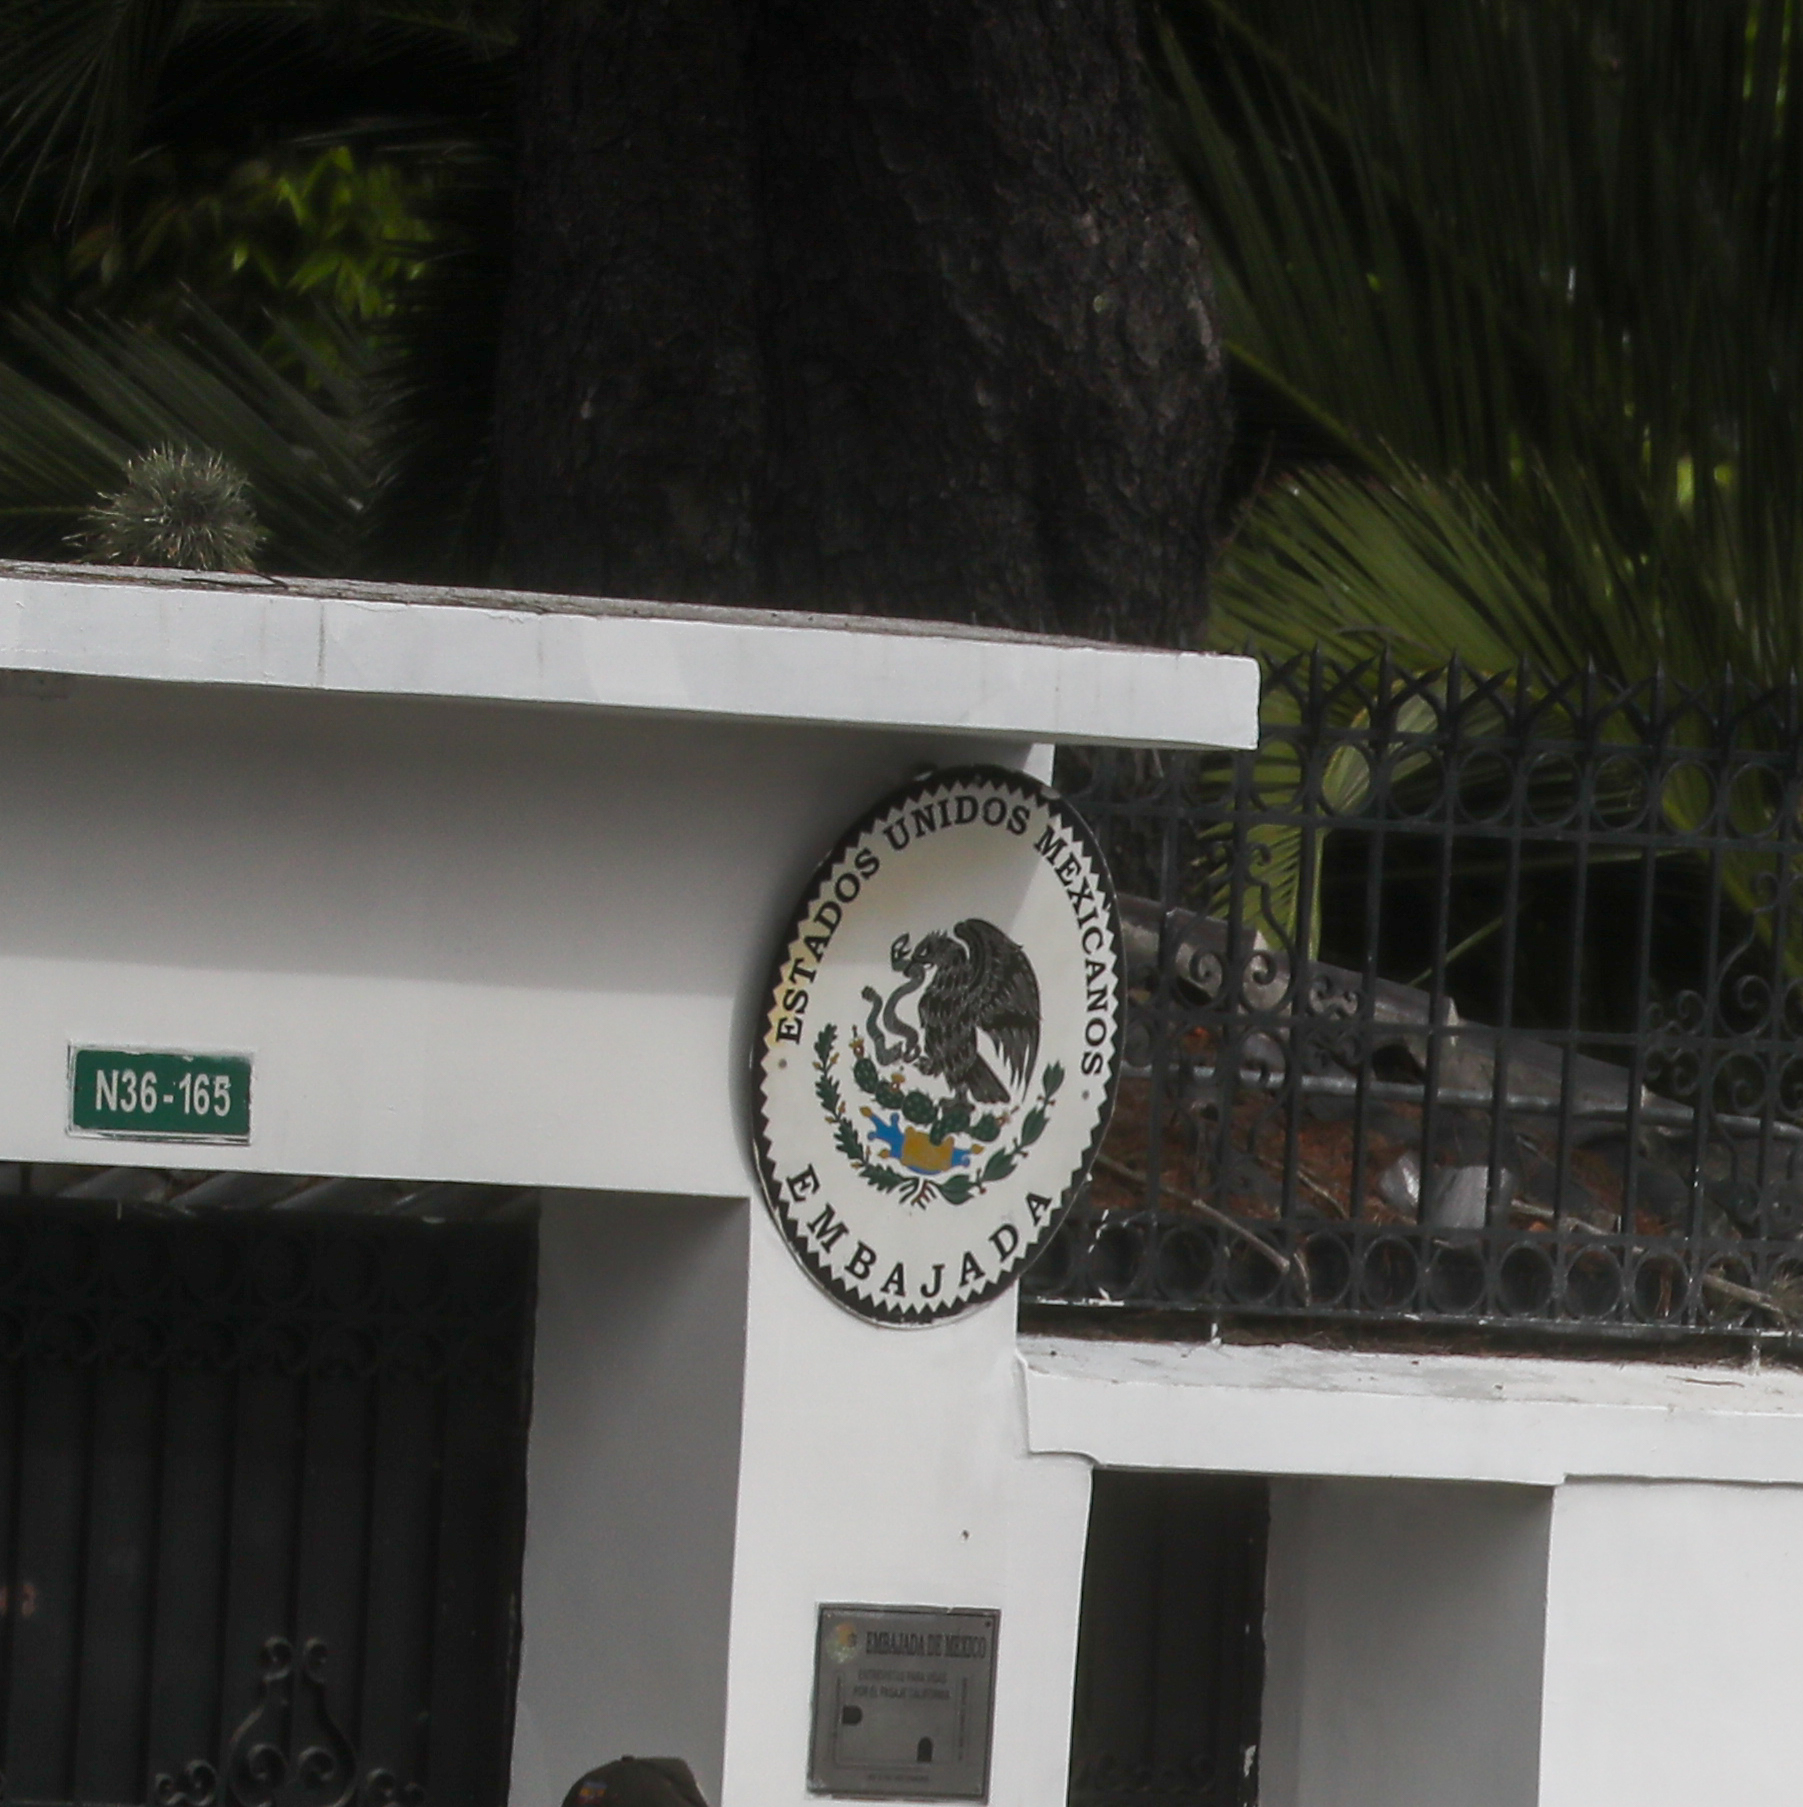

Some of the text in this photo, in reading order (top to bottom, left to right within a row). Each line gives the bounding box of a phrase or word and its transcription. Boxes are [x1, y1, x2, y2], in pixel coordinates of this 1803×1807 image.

[775, 793, 1108, 1077] ESTADOS UNIDOS MEXICANOS
[95, 1068, 232, 1117] N36-165
[785, 1163, 1053, 1300] EMBAJADA
[866, 1631, 925, 1656] EMBAJADA
[927, 1633, 943, 1657] DE
